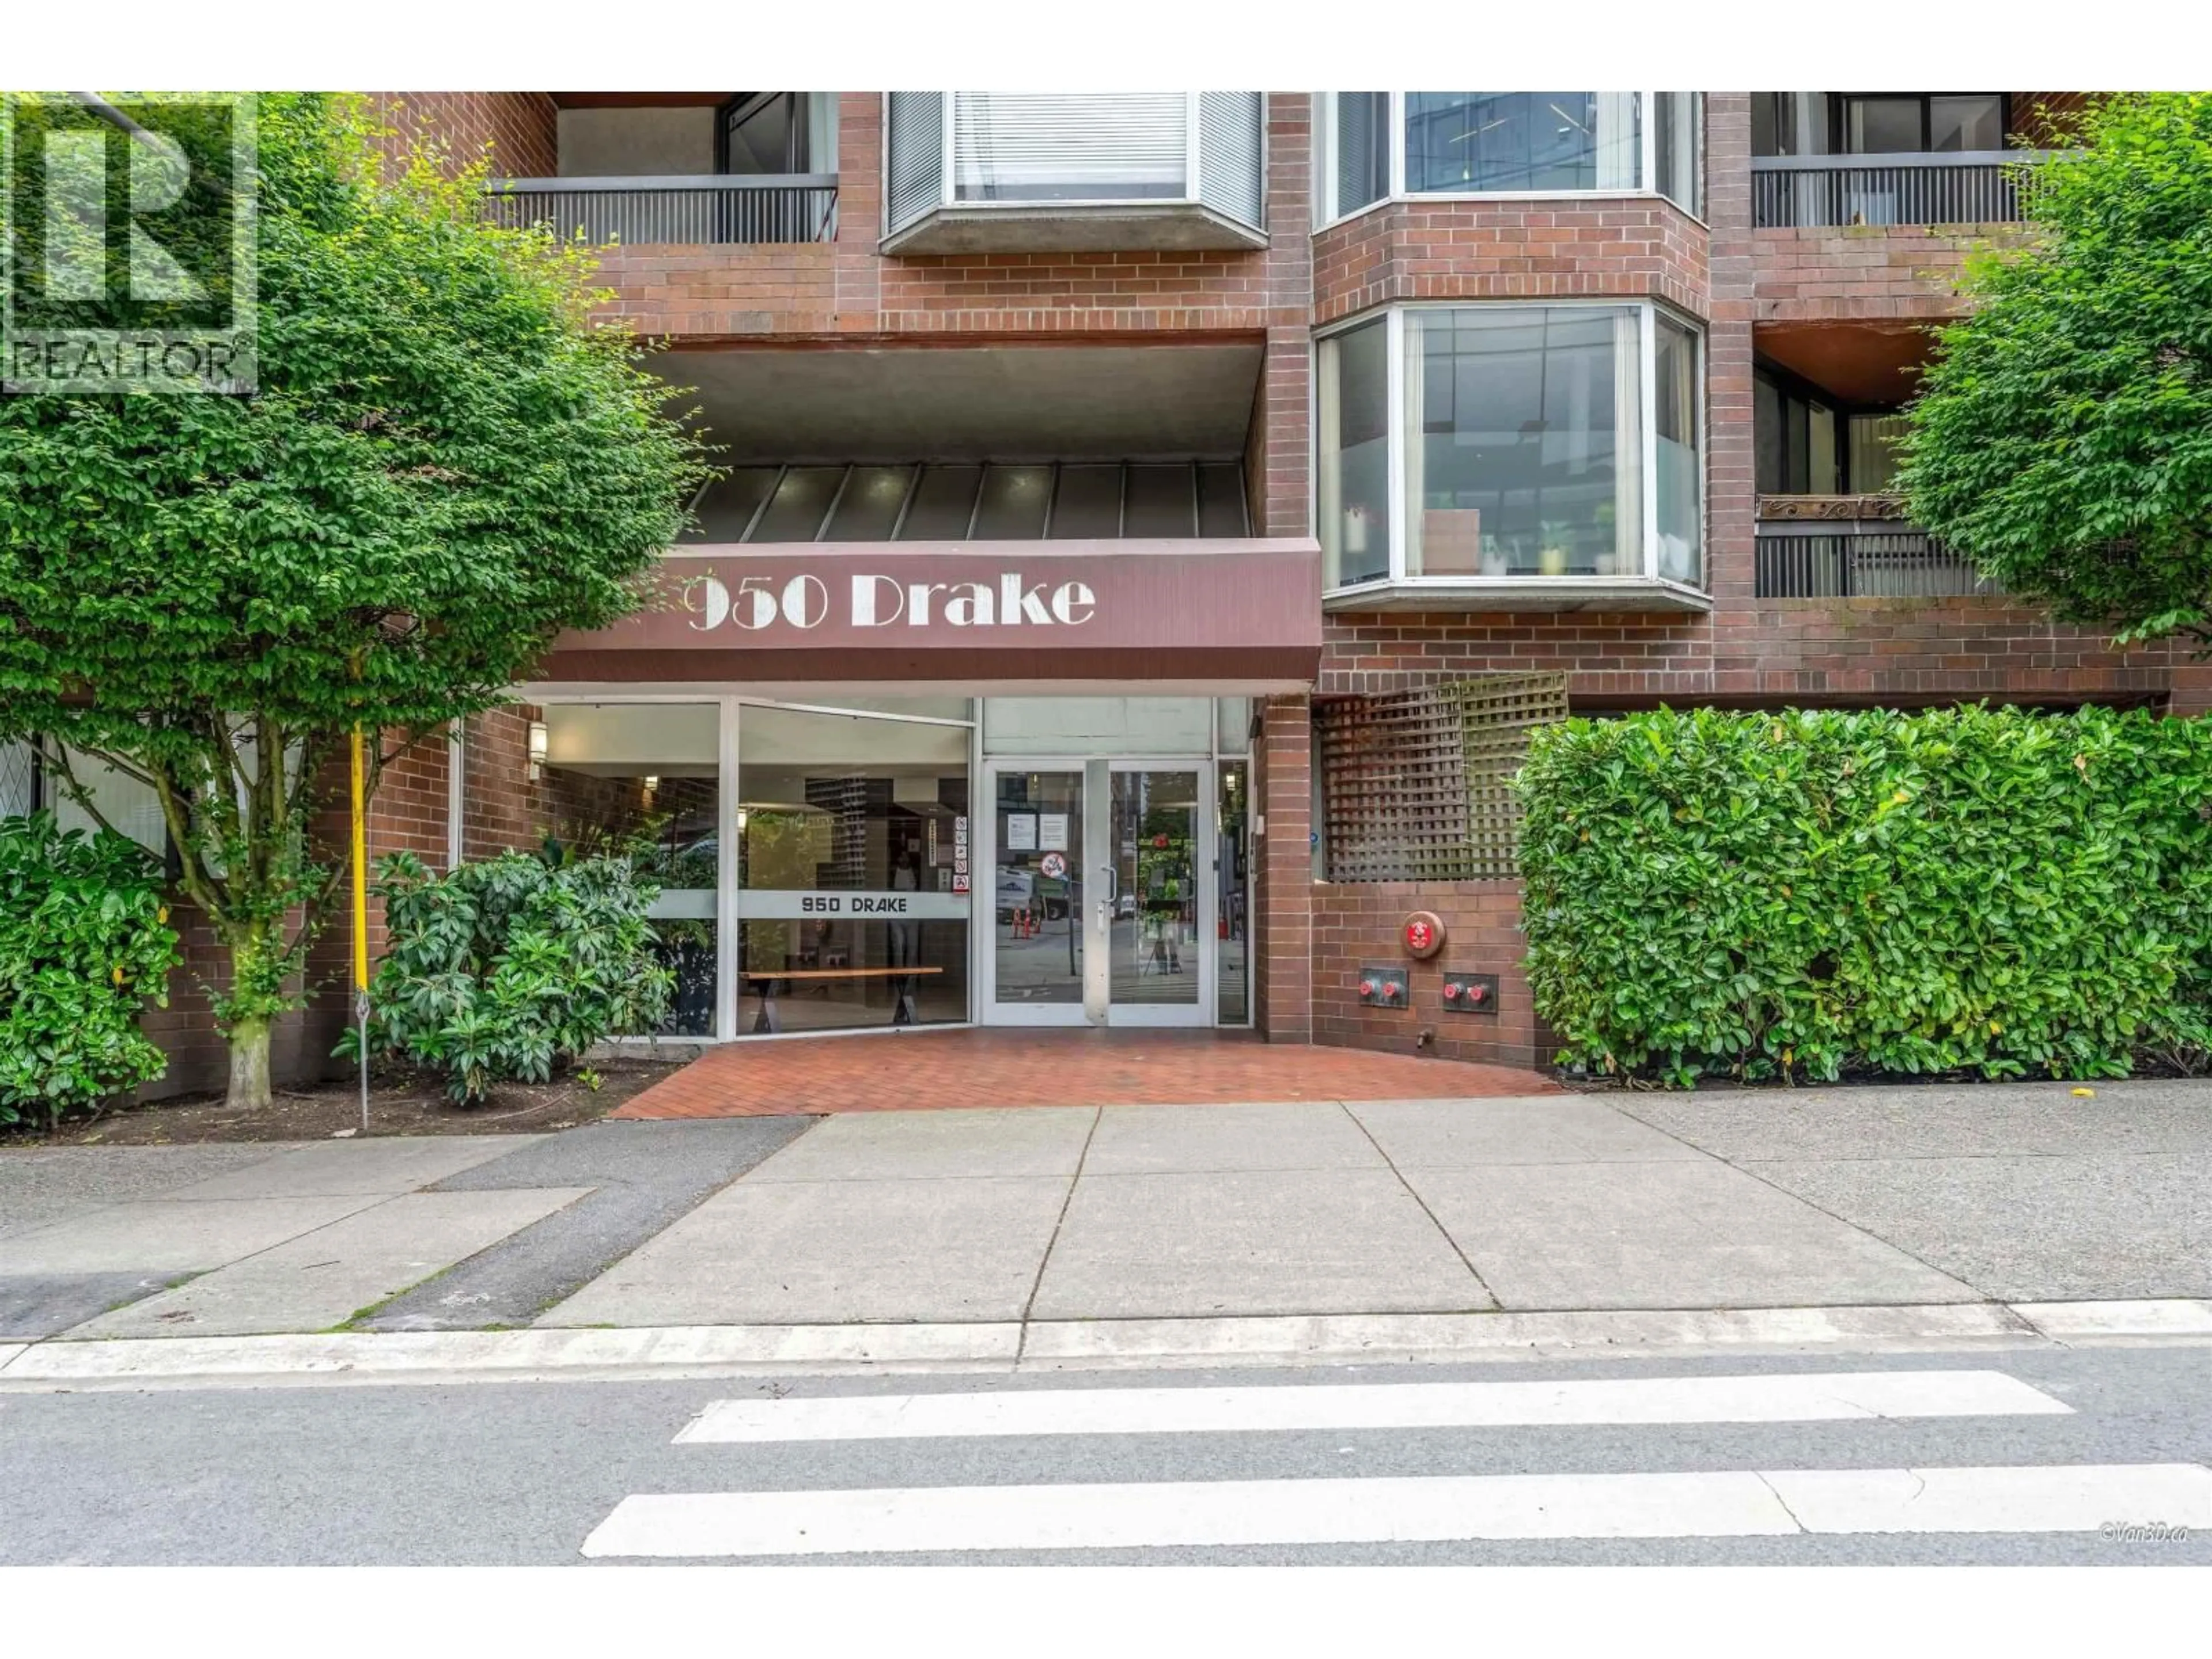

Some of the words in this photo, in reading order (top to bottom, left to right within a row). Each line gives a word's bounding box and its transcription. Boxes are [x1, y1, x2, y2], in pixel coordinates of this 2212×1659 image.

[683, 574, 828, 630] 950
[851, 574, 1096, 627] Drake
[801, 896, 840, 912] 950
[851, 897, 907, 912] DRAKE
